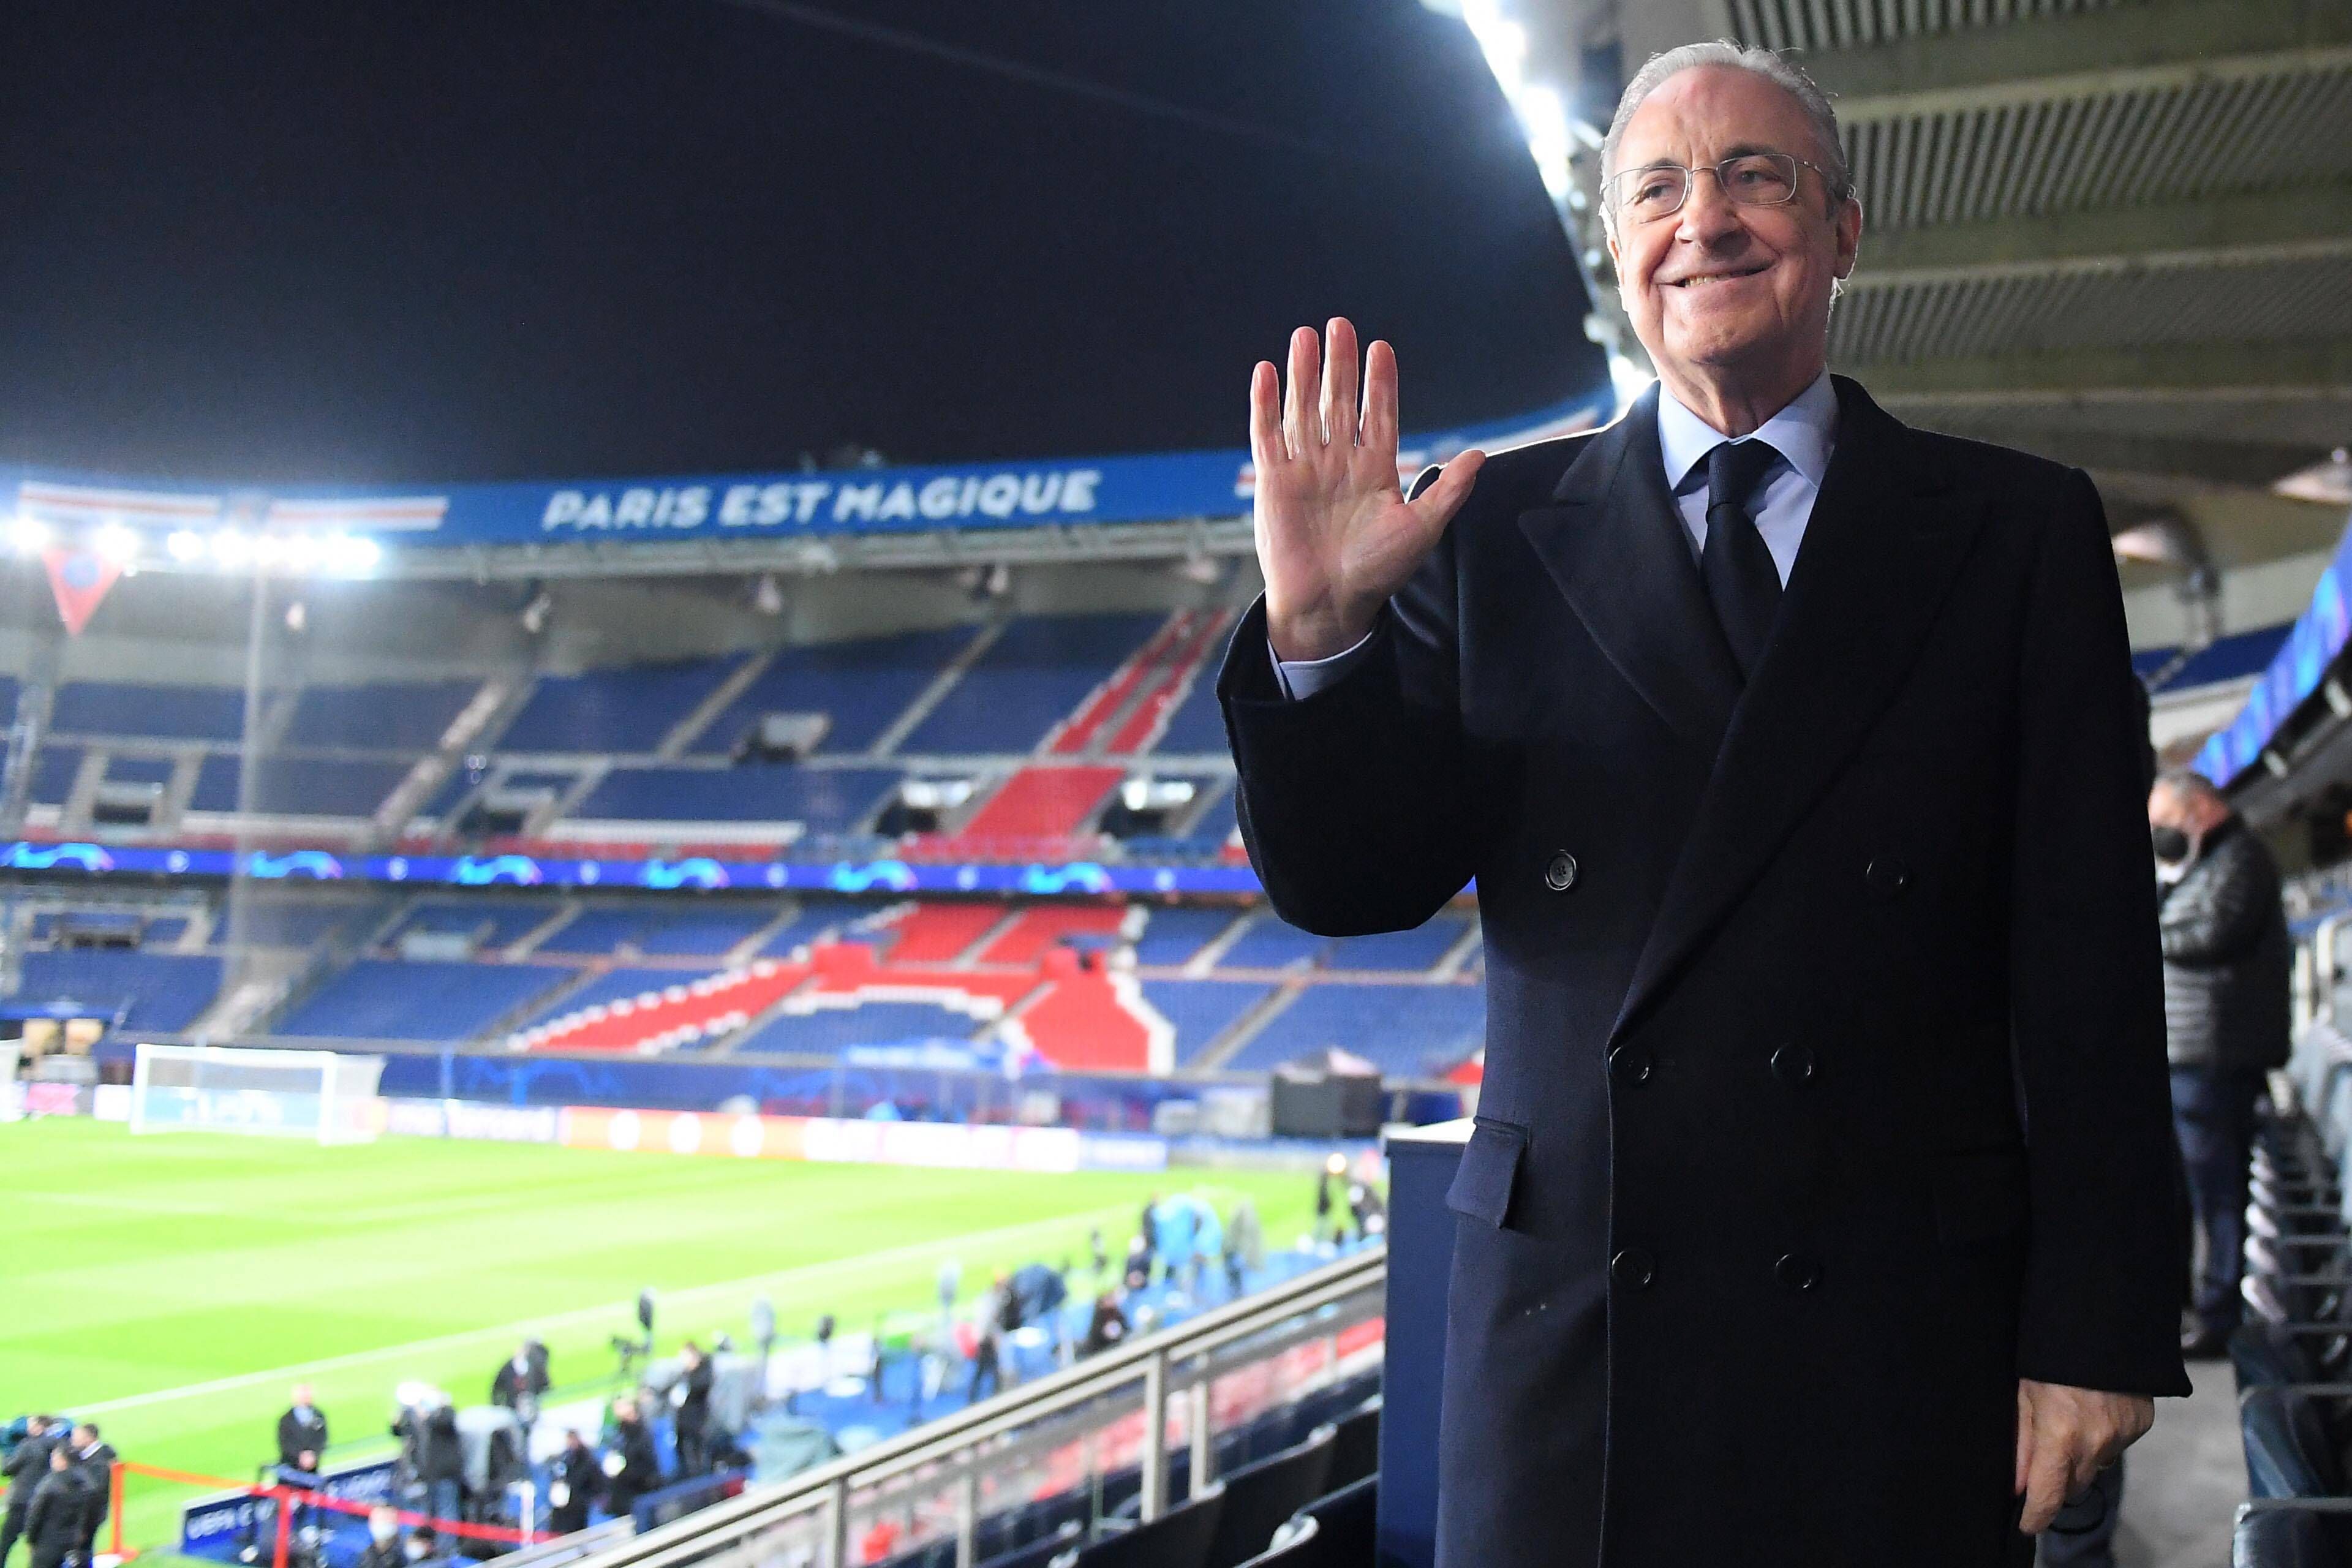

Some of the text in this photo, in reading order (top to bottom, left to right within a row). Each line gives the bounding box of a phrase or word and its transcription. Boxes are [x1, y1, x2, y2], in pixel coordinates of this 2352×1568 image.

[541, 469, 1101, 532] PARIS EST MAGIQUE
